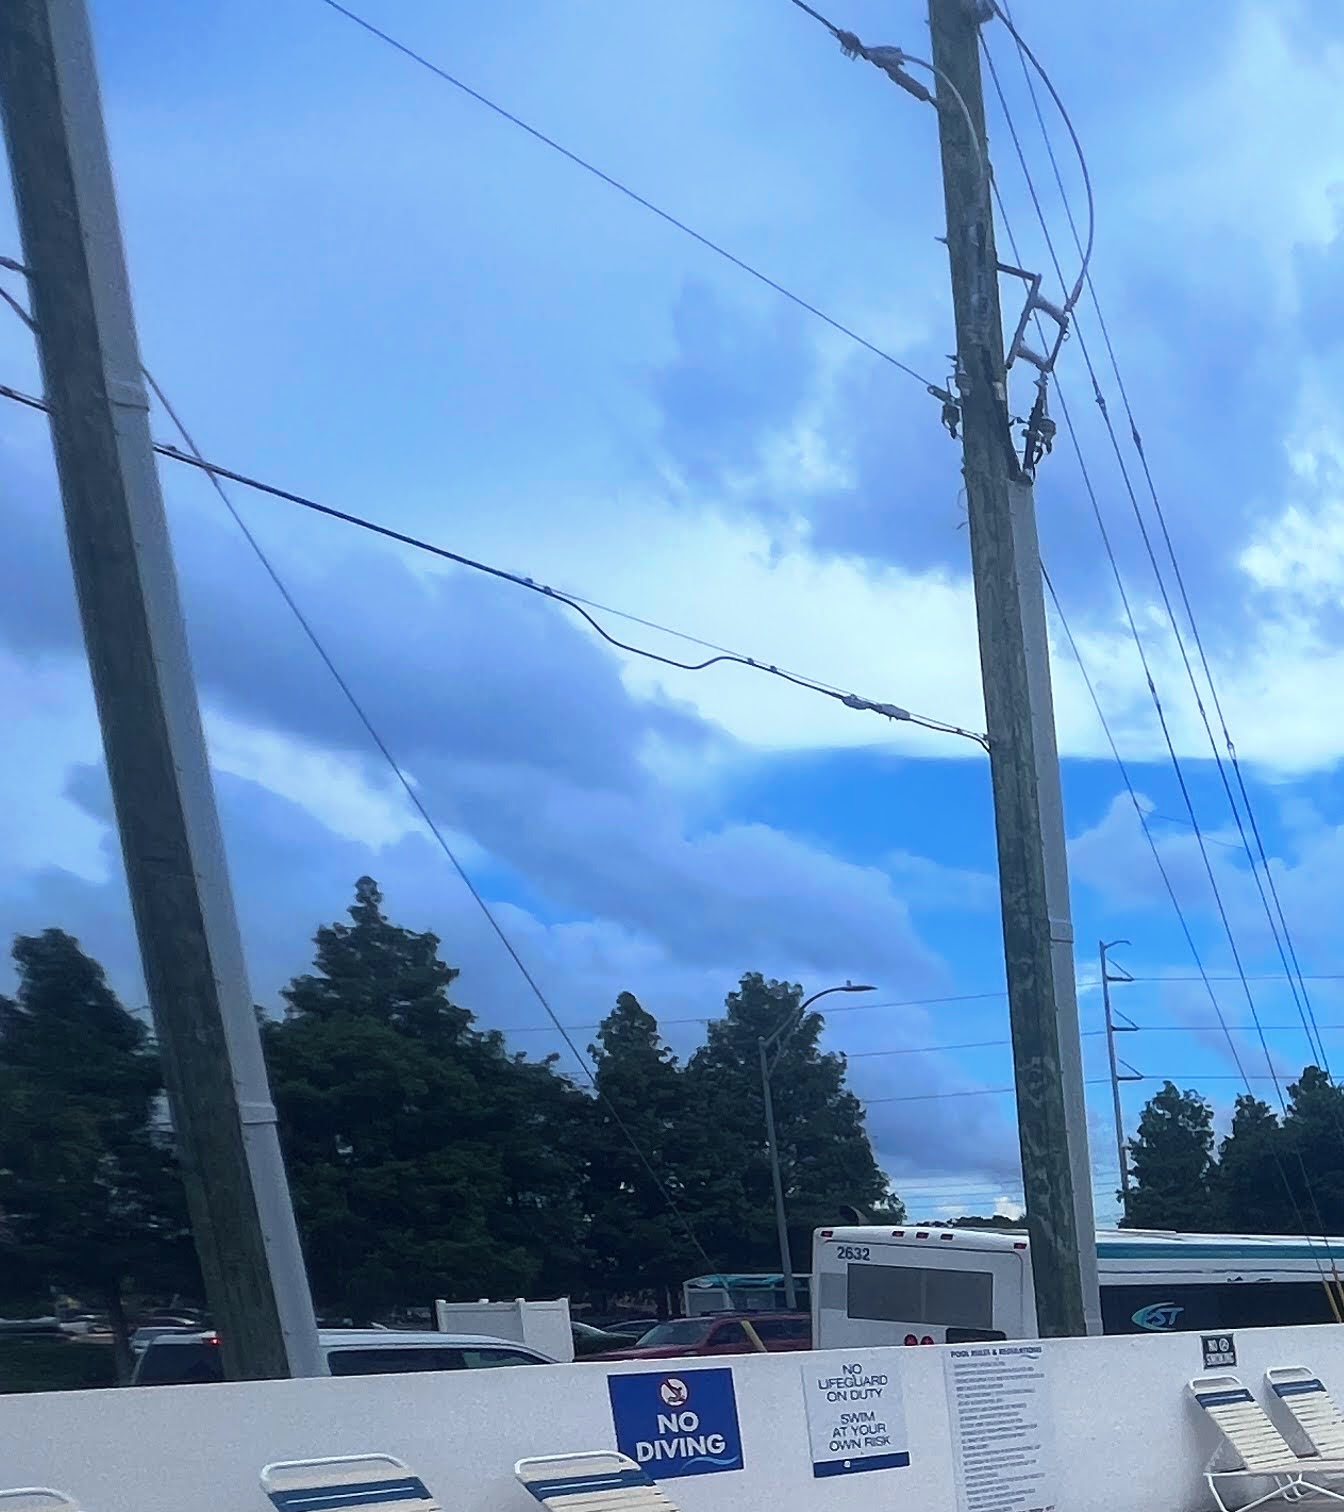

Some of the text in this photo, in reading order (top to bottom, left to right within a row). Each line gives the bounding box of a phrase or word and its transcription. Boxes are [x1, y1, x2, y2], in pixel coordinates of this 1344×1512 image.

[837, 1246, 870, 1261] 2632
[842, 1363, 863, 1375] NO
[818, 1375, 888, 1390] LIFEGUARD
[827, 1388, 883, 1402] ON DUTY
[656, 1411, 699, 1434] NO
[840, 1410, 876, 1425] SWIM
[832, 1423, 887, 1438] AT YOUR
[635, 1433, 726, 1462] DIVING
[829, 1435, 891, 1452] OWN RISK
